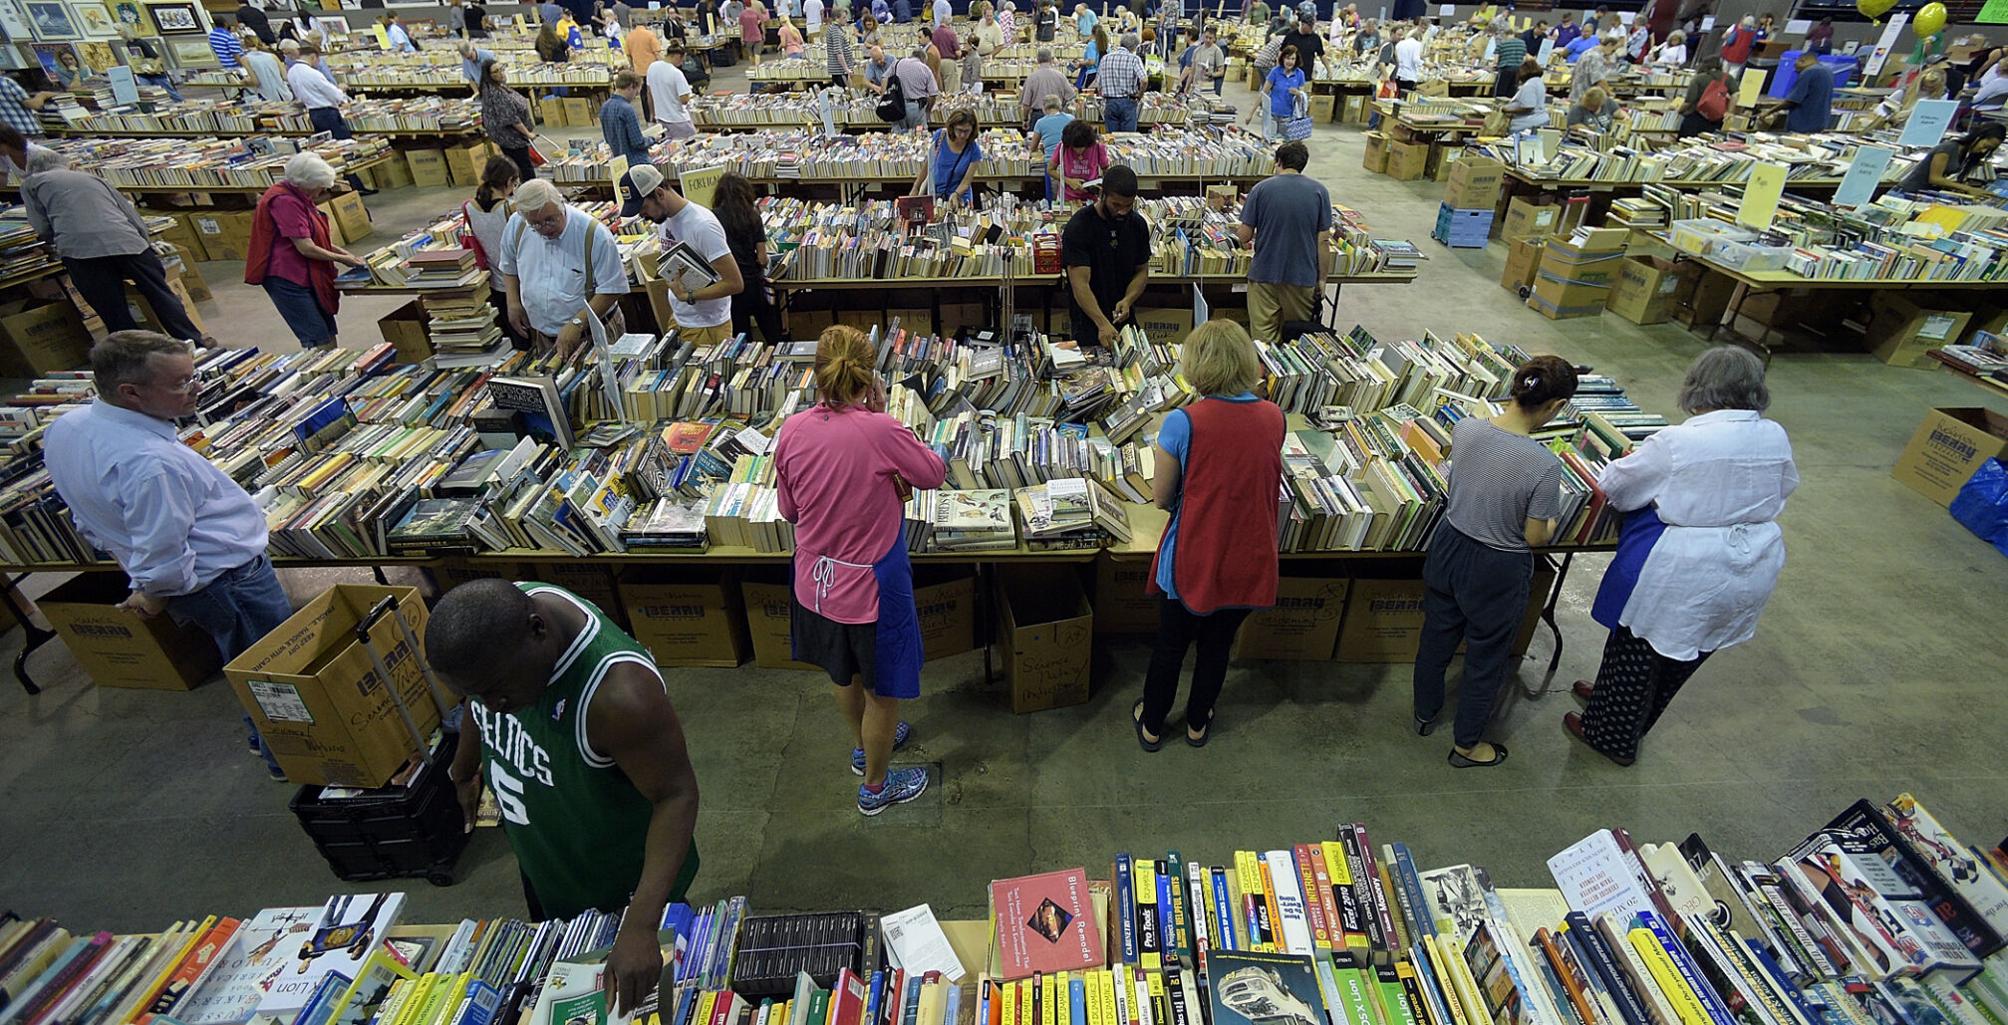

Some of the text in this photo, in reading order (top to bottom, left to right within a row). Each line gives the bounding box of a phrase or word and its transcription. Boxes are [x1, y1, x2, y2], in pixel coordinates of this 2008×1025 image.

[1927, 429, 1977, 459] BERRY
[644, 606, 705, 618] BERRY
[470, 699, 555, 788] CELTICS
[1170, 876, 1181, 896] HINTS
[1301, 863, 1318, 902] INTERNET
[1372, 876, 1387, 911] Masonry
[1068, 876, 1093, 962] Blueprint Remodel
[1173, 897, 1185, 926] HELPFUL
[1259, 905, 1270, 930] Macs
[1340, 886, 1358, 930] Excel 2010
[1123, 920, 1133, 956] CABINETRY
[1142, 909, 1153, 948] Pro Tools
[1643, 932, 1665, 960] Manual
[277, 981, 310, 995] Lion
[1348, 979, 1362, 1001] Lion
[1589, 934, 1646, 1022] CONSTRUCTION DETAILS
[1396, 993, 1412, 1017] Lion
[1444, 977, 1463, 1019] Sunrooms
